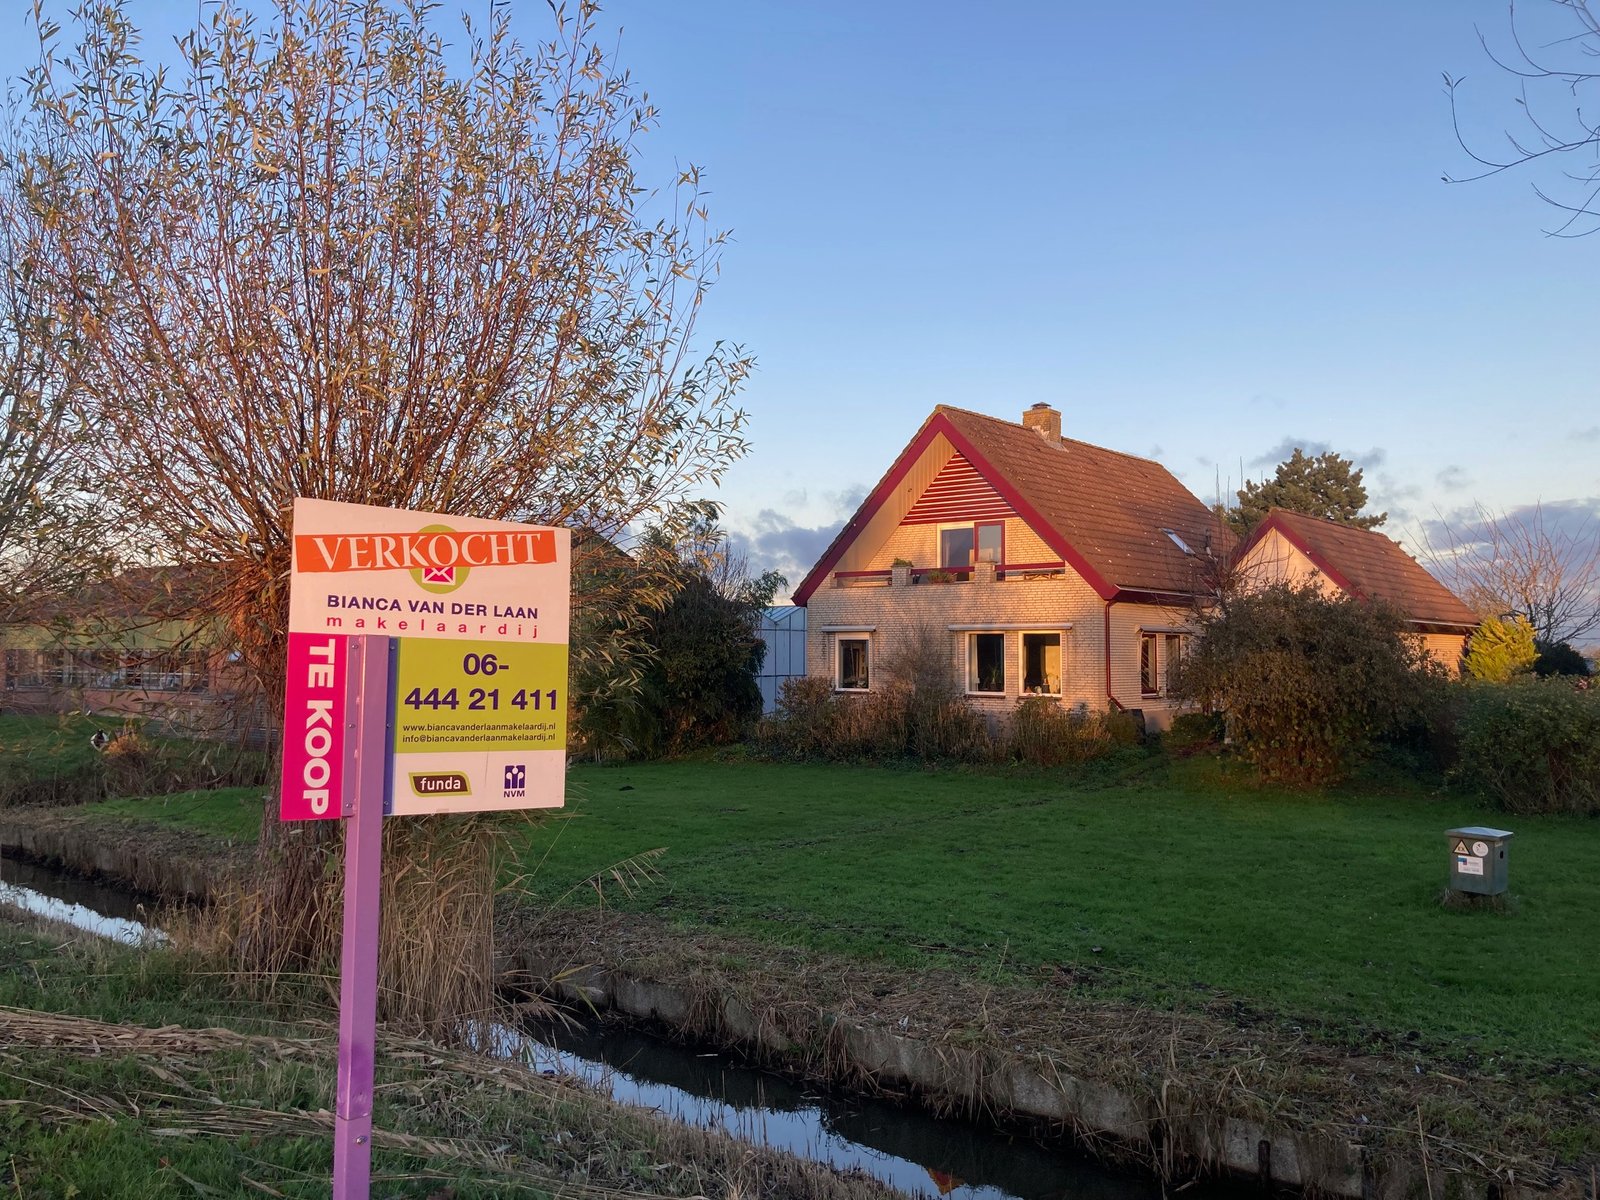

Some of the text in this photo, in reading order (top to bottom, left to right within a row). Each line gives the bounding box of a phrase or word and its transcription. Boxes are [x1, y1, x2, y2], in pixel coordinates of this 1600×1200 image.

[312, 533, 541, 570] VERKOCHT
[327, 594, 538, 619] BIANCA VAN DER LAAN
[327, 616, 538, 638] makelaardij
[463, 653, 509, 676] 06-
[404, 687, 557, 710] 444 21 411
[303, 638, 336, 815] TE KOOP
[403, 722, 556, 732] www.biancavanderlaanmakelaardij.nl
[403, 733, 555, 743] info@biancavanderlaanmakelaardij.nl
[420, 776, 461, 791] funda
[503, 790, 525, 798] NVM
